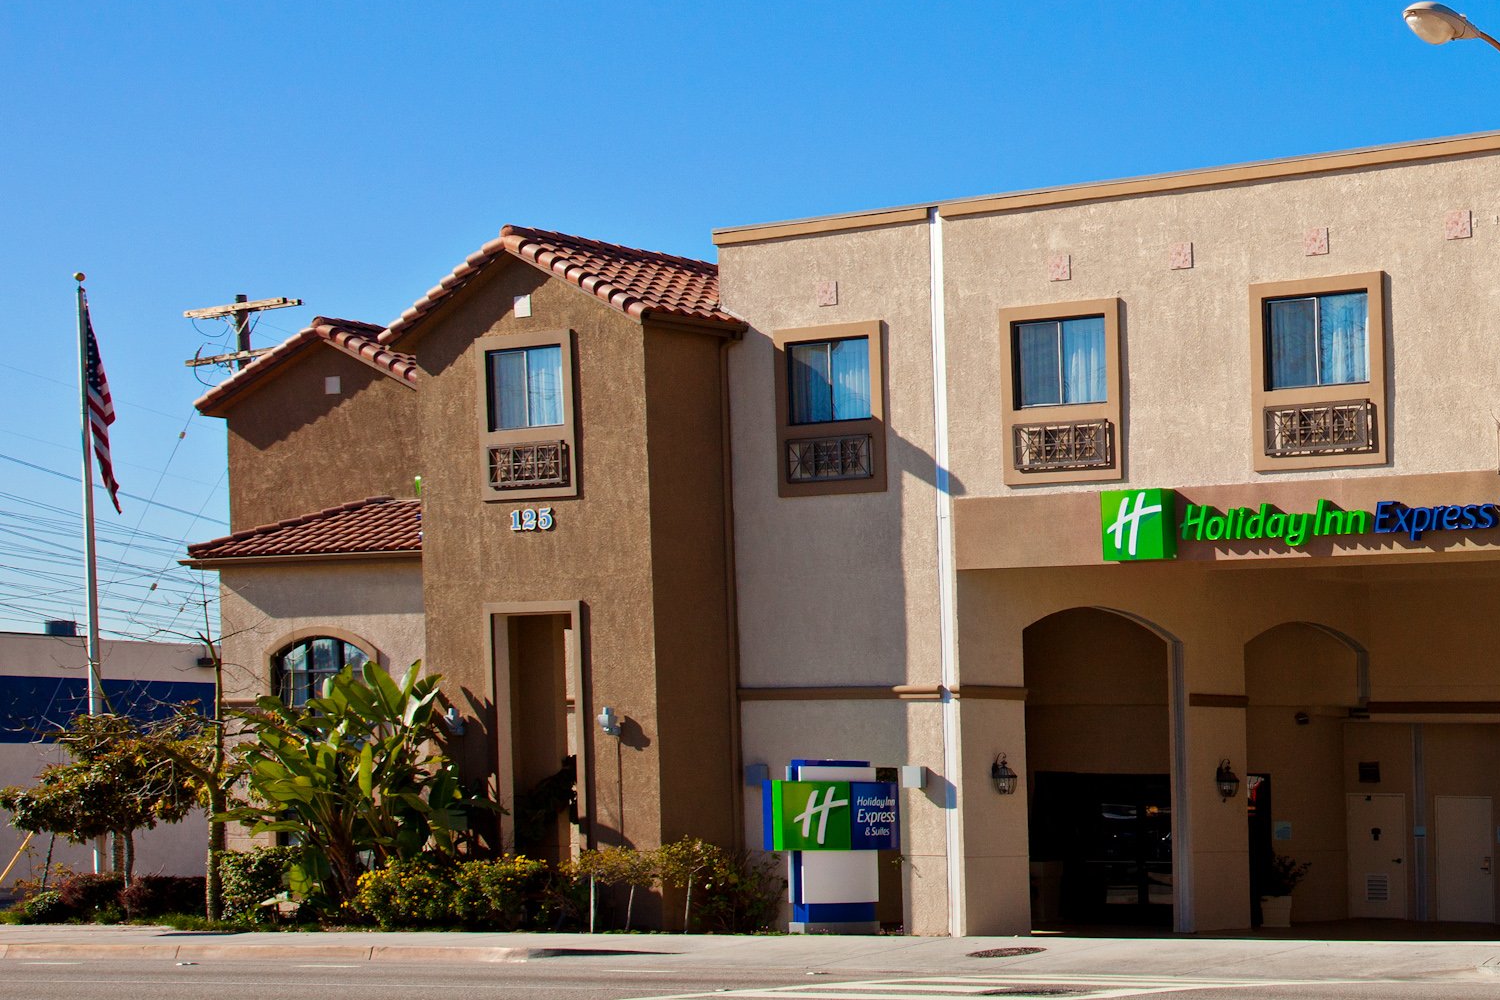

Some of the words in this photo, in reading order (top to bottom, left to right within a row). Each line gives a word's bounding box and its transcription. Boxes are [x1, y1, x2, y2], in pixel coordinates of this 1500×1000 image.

[510, 507, 553, 531] 125
[1180, 503, 1311, 546] Holiday
[1314, 498, 1371, 536] Inn
[1373, 501, 1498, 542] Express
[857, 796, 885, 808] Holiday
[884, 796, 896, 806] Inn
[857, 809, 896, 826] Express
[865, 828, 871, 836] &
[871, 827, 890, 836] Suites
